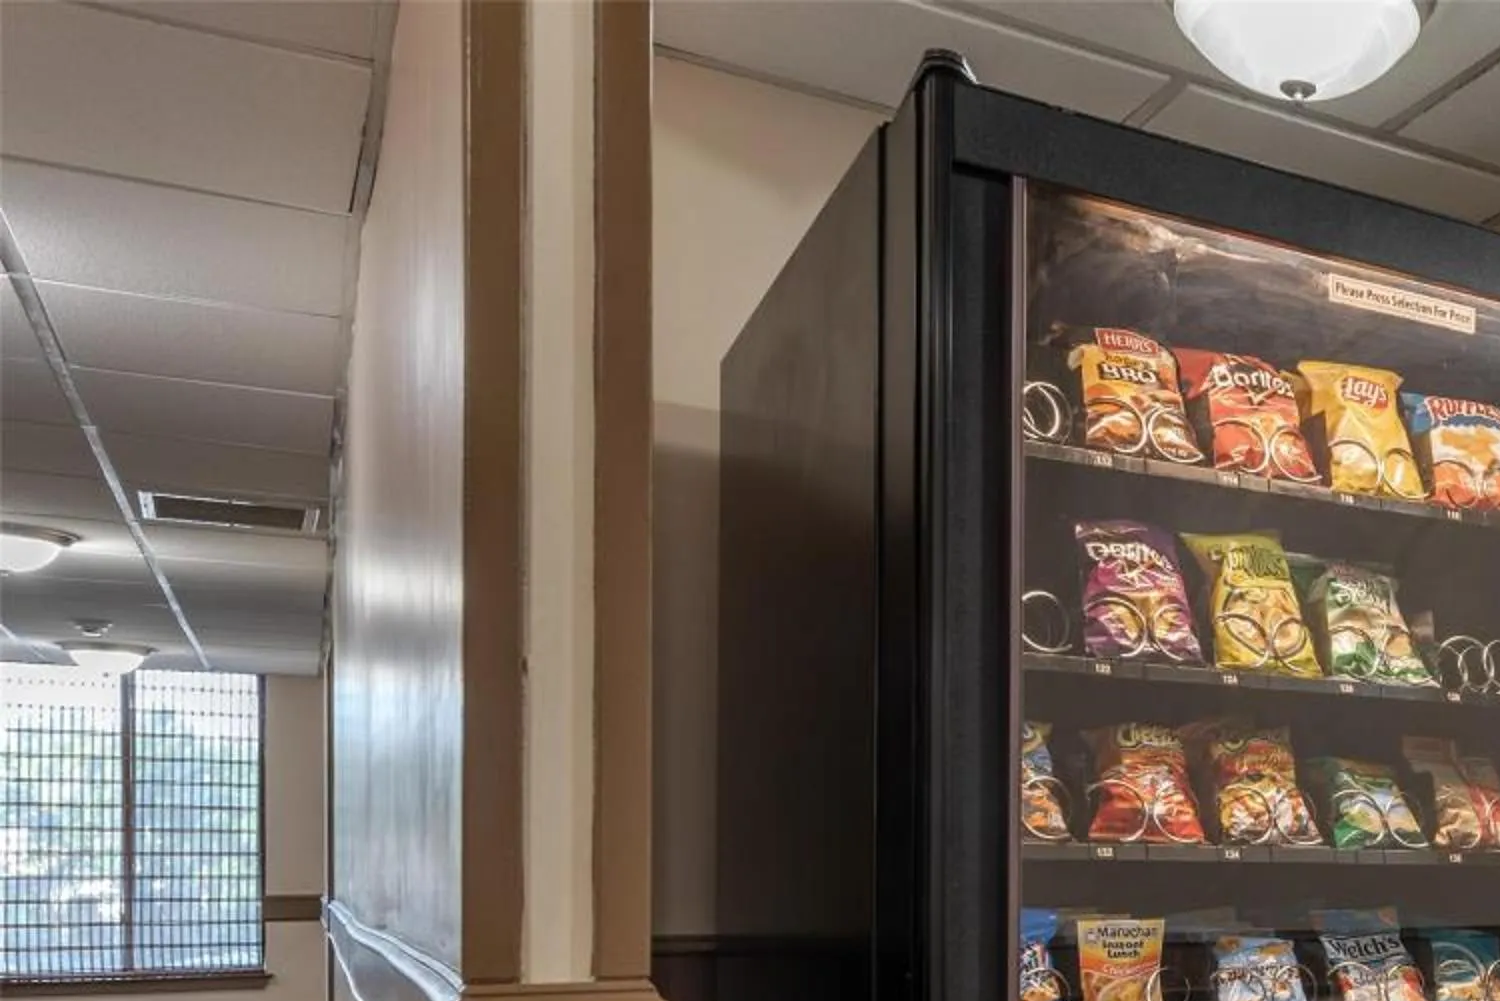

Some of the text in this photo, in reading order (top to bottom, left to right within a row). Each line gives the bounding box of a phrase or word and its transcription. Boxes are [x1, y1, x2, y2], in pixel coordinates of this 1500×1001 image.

[1335, 281, 1365, 299] Please
[1366, 289, 1391, 305] Press
[1391, 295, 1432, 315] Selection
[1433, 305, 1447, 318] For
[1211, 362, 1295, 397] Doritos
[1343, 375, 1388, 407] Lay's
[1097, 926, 1158, 939] Maruchan
[1107, 950, 1141, 959] Lunch
[1327, 934, 1400, 961] Welch's
